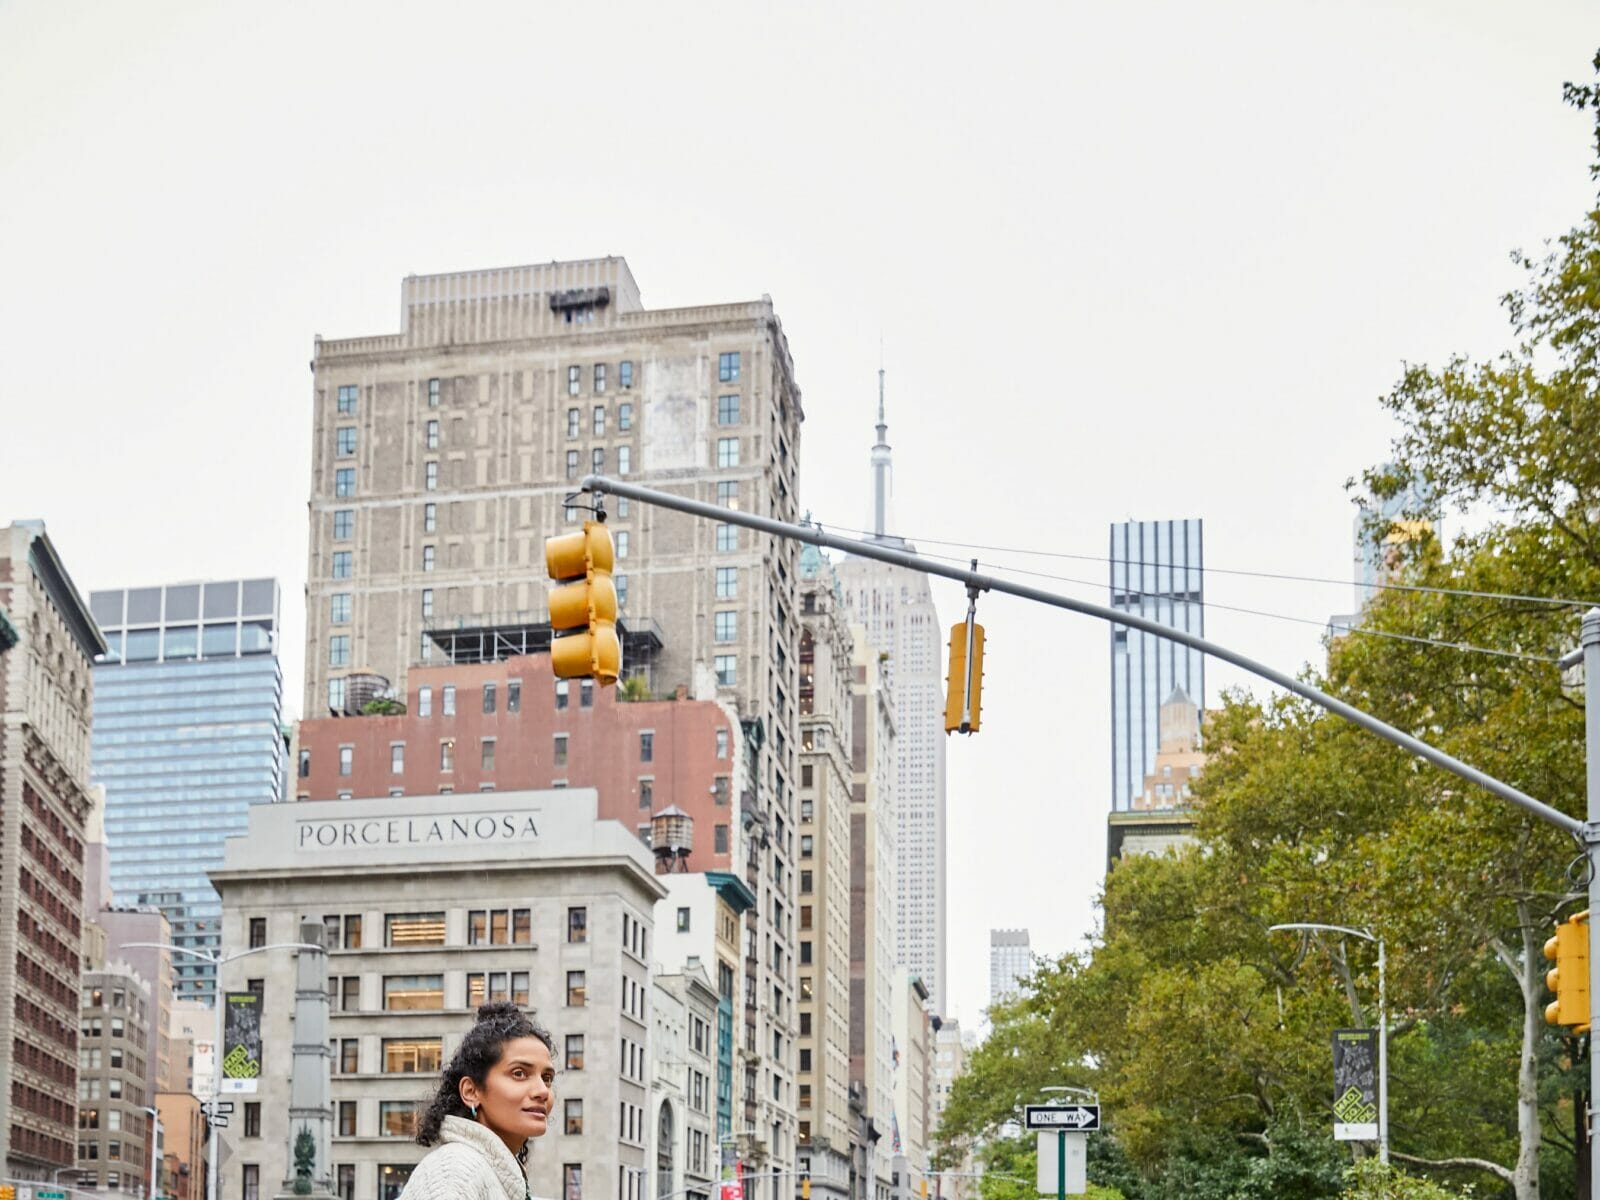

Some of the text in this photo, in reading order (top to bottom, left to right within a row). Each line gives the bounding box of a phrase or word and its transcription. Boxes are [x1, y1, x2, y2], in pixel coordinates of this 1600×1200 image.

[300, 815, 539, 847] PORCELANOSA
[1036, 1112, 1088, 1123] ONE WAY
